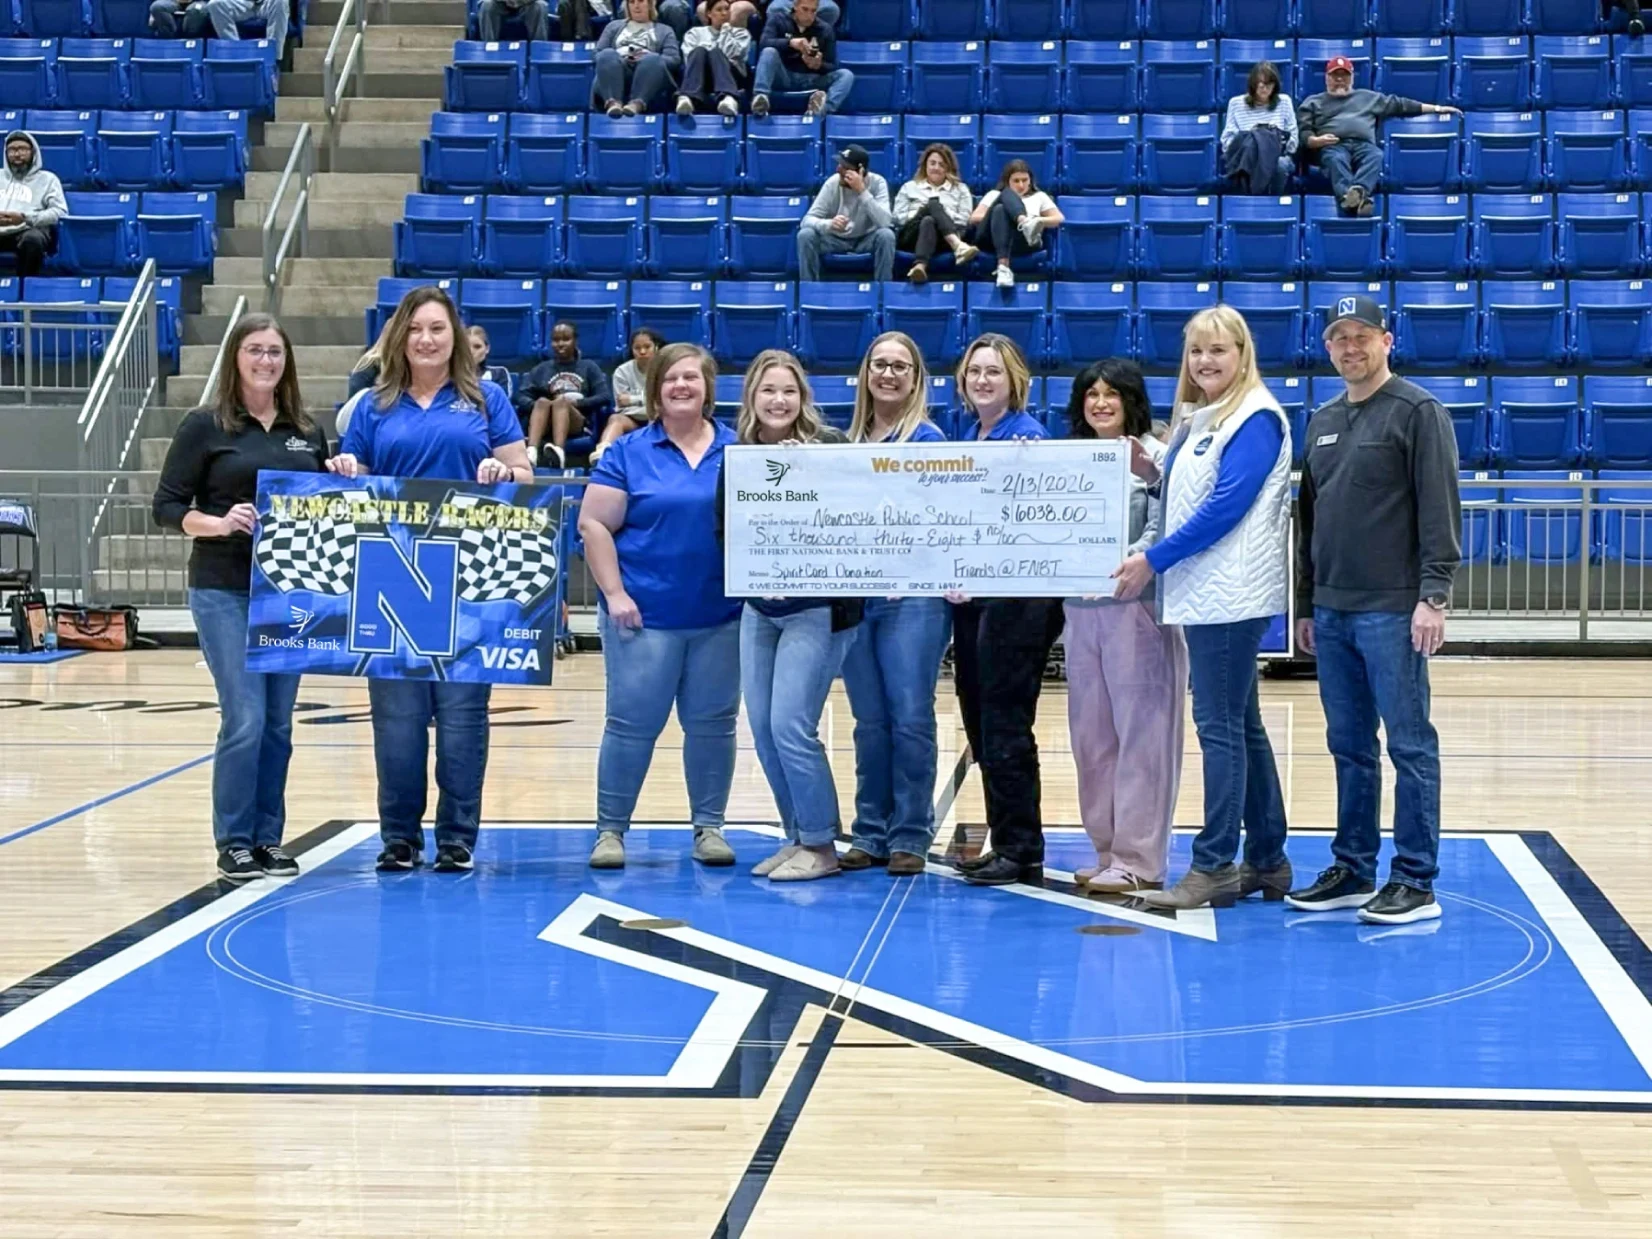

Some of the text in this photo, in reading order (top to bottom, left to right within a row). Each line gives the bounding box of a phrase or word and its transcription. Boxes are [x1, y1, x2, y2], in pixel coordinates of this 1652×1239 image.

[1338, 297, 1356, 316] N
[871, 457, 900, 473] We
[1092, 452, 1117, 462] 1892
[1002, 472, 1095, 498] 2/13/2026
[737, 490, 819, 502] Brooks Bank
[268, 494, 549, 532] NEWCASTLE RACERS
[883, 505, 921, 526] Public
[925, 505, 973, 526] School
[1015, 504, 1088, 523] 6038.00
[754, 526, 780, 546] Six
[788, 527, 858, 546] thousand
[1078, 536, 1117, 544] DOLLARS
[869, 547, 895, 555] TRUST
[771, 561, 883, 580] Spirit Card Donation
[954, 558, 996, 578] Friends
[1018, 559, 1062, 576] FNBT
[350, 535, 460, 657] N
[259, 635, 341, 650] Brooks Bank
[504, 627, 542, 640] DEBIT
[475, 646, 541, 671] VISA
